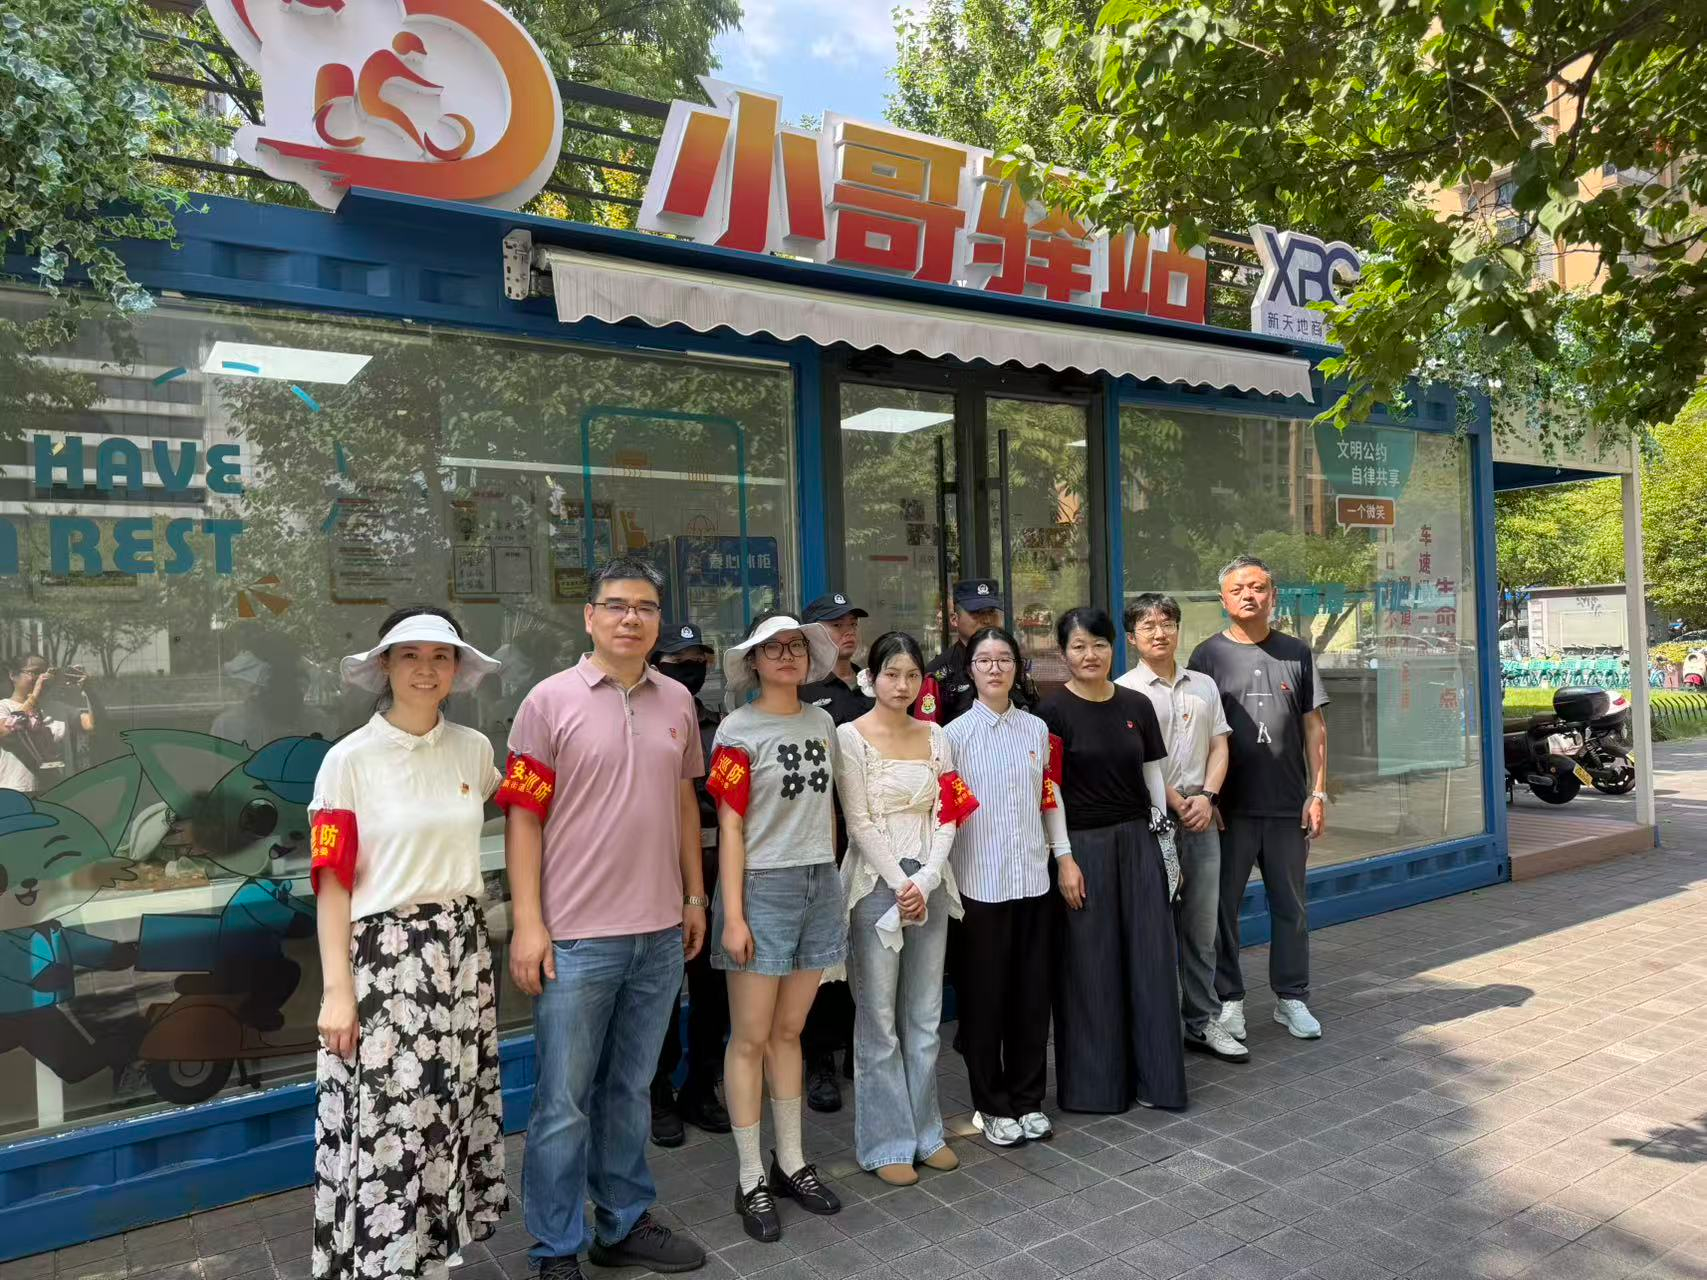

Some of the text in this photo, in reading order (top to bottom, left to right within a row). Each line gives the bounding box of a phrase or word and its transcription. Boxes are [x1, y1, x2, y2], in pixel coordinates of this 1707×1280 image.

[658, 90, 1206, 324] 小哥驿站
[33, 434, 243, 494] HAVE
[1336, 439, 1387, 463] 文明公约
[1351, 465, 1401, 488] 自律共享
[1347, 503, 1386, 521] 一个微笑
[50, 516, 243, 577] REST
[717, 754, 746, 786] 巡防
